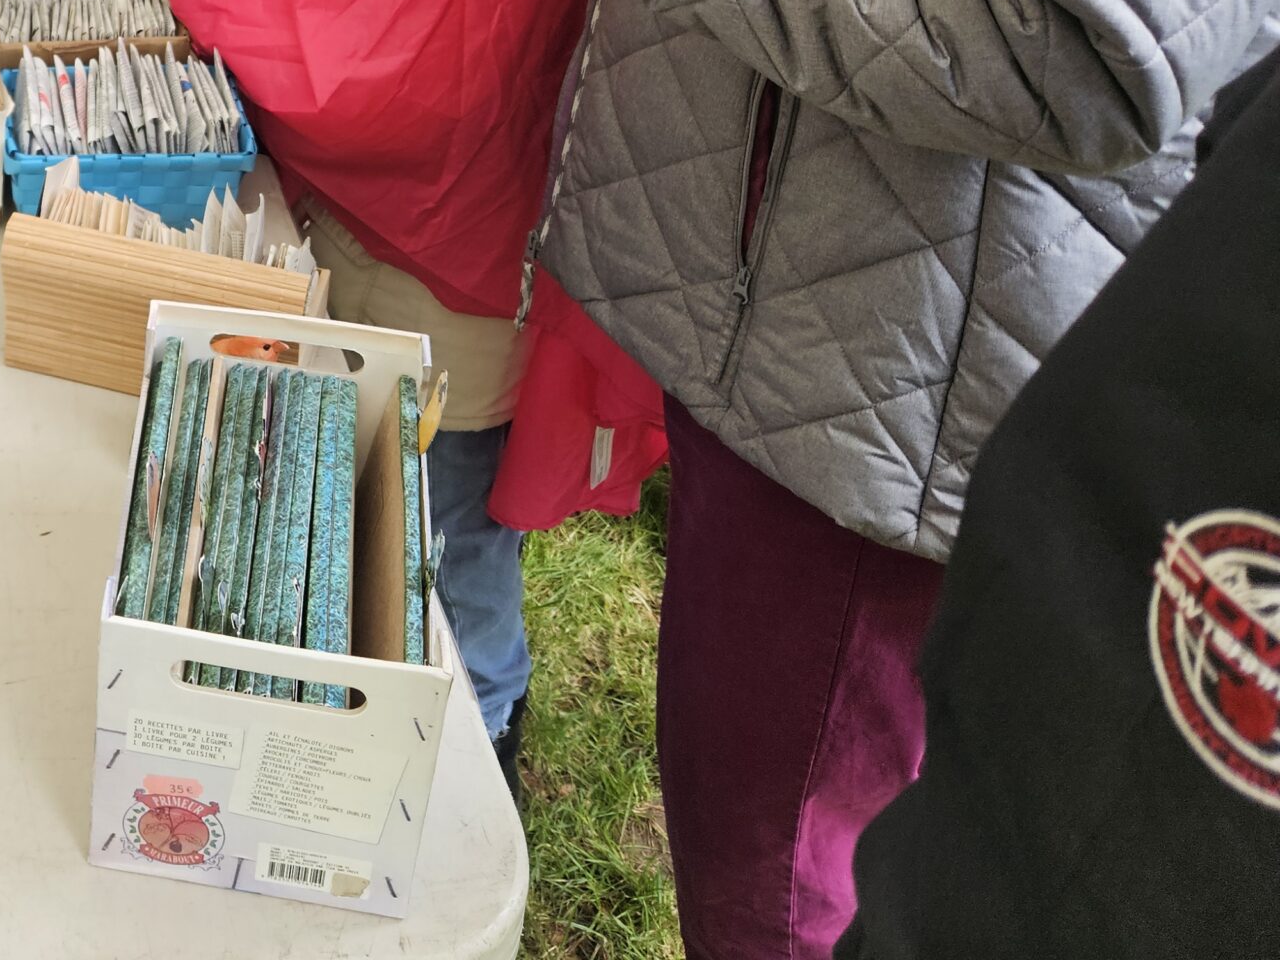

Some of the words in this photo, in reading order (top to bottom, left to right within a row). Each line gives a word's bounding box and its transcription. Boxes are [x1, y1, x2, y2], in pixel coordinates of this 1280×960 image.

[142, 727, 164, 736] LIVRE
[148, 720, 183, 731] RECETTES
[206, 731, 228, 739] LIVRE
[186, 749, 216, 759] CUISINE
[310, 747, 337, 756] ASPERGES
[329, 744, 354, 754] OIGNONS
[307, 753, 336, 762] POIVRONS
[287, 773, 312, 782] FENOUIL
[289, 780, 324, 791] COURGETTES
[292, 786, 316, 795] SALADES
[280, 789, 307, 800] HARICOTS
[152, 796, 205, 815] PRIMEUR
[274, 800, 297, 809] TOMATES
[150, 849, 196, 864] MARABOUT
